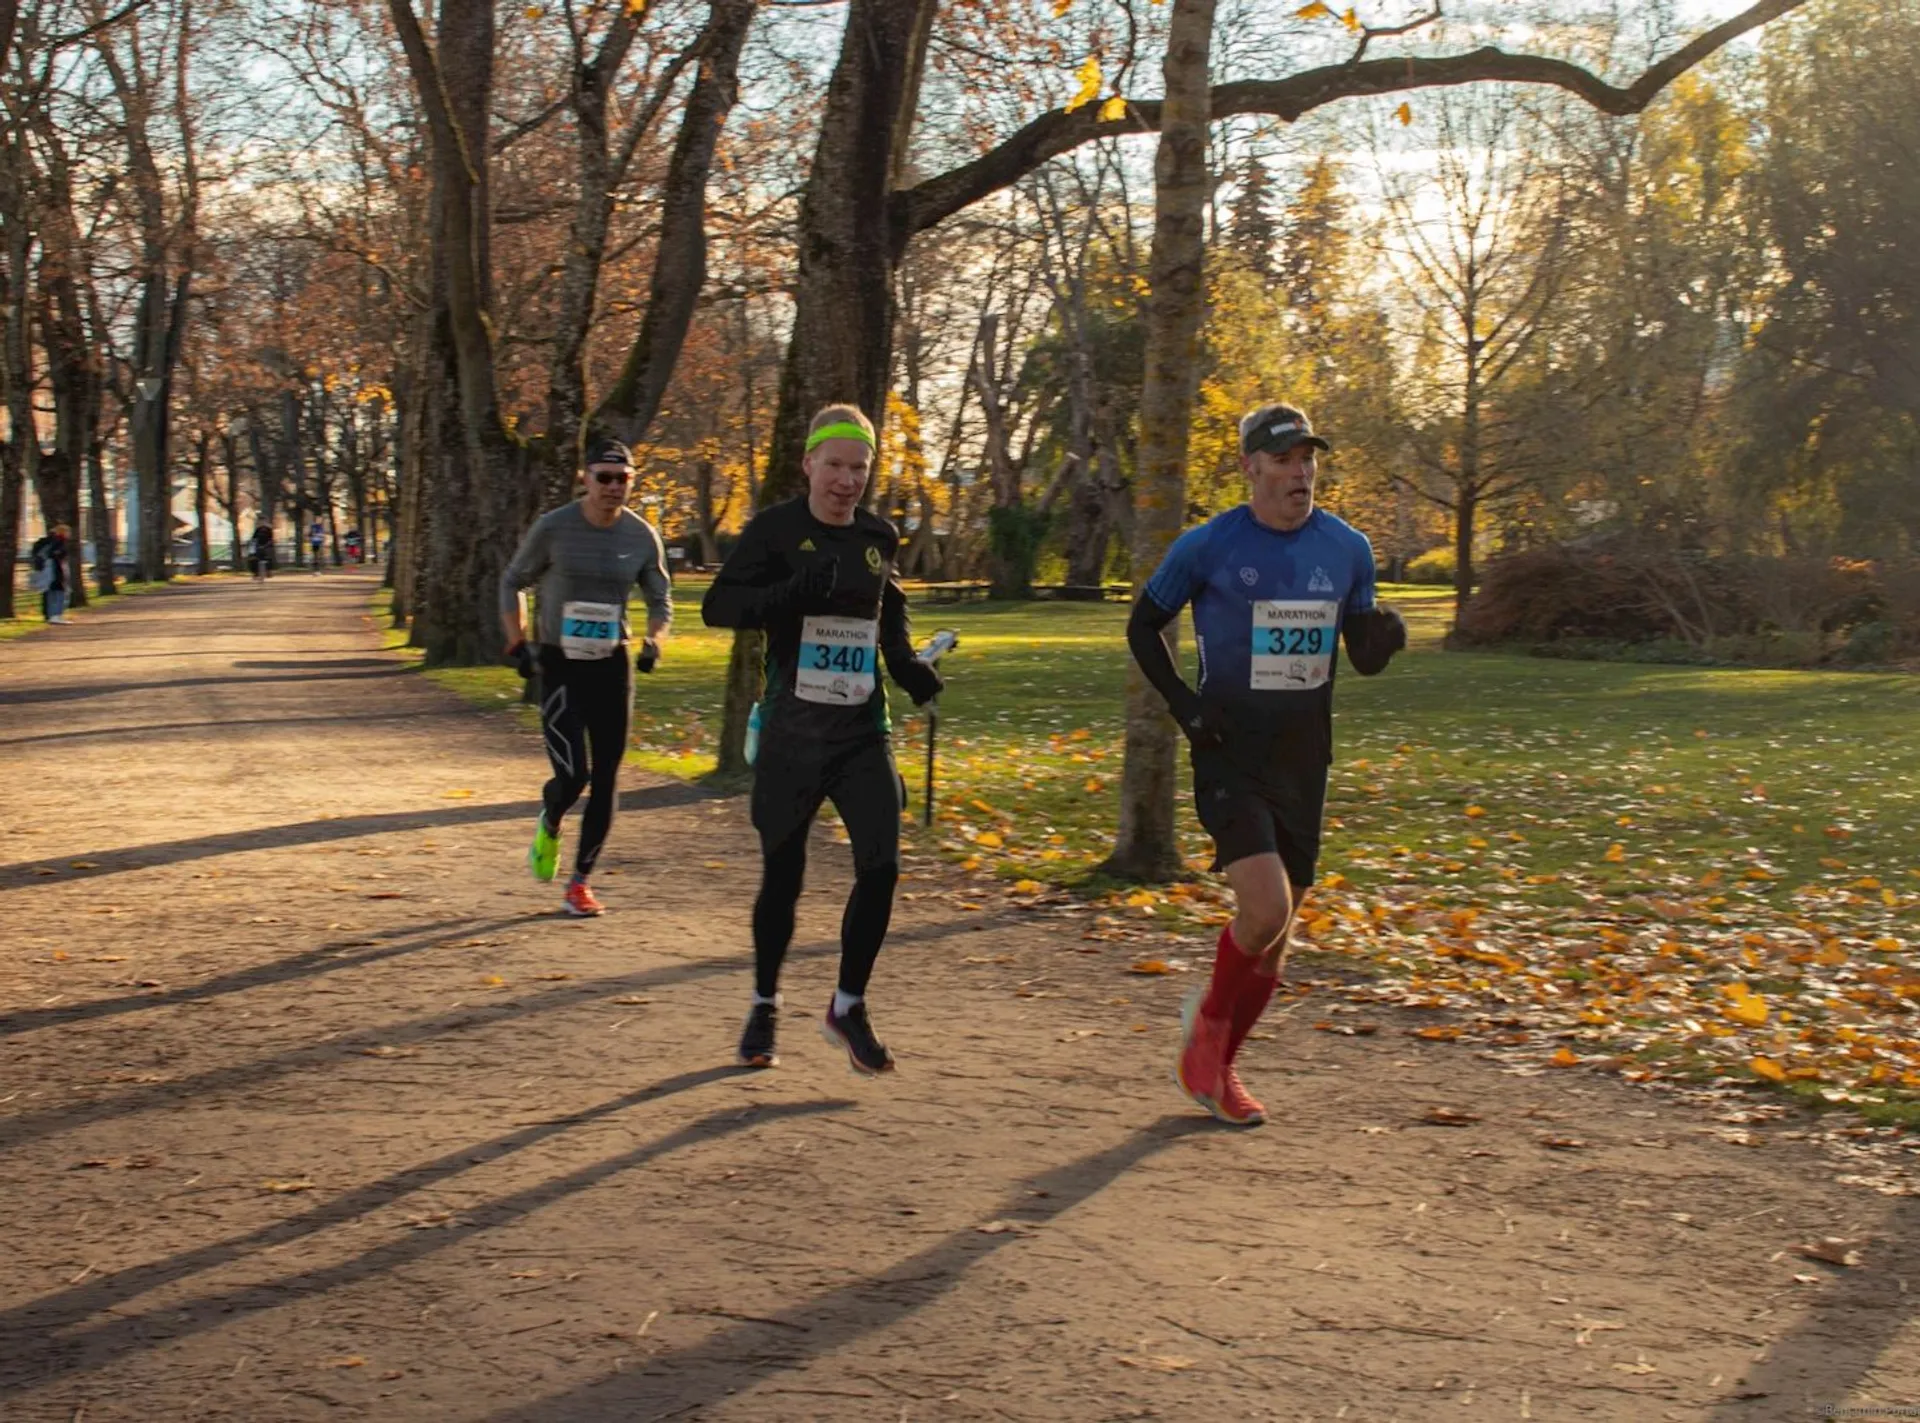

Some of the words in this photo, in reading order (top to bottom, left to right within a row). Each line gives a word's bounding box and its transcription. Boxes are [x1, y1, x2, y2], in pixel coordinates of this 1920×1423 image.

[1267, 609, 1326, 620] MARATHON
[815, 628, 869, 640] MARATHON
[1267, 627, 1322, 655] 329
[813, 644, 865, 672] 340
